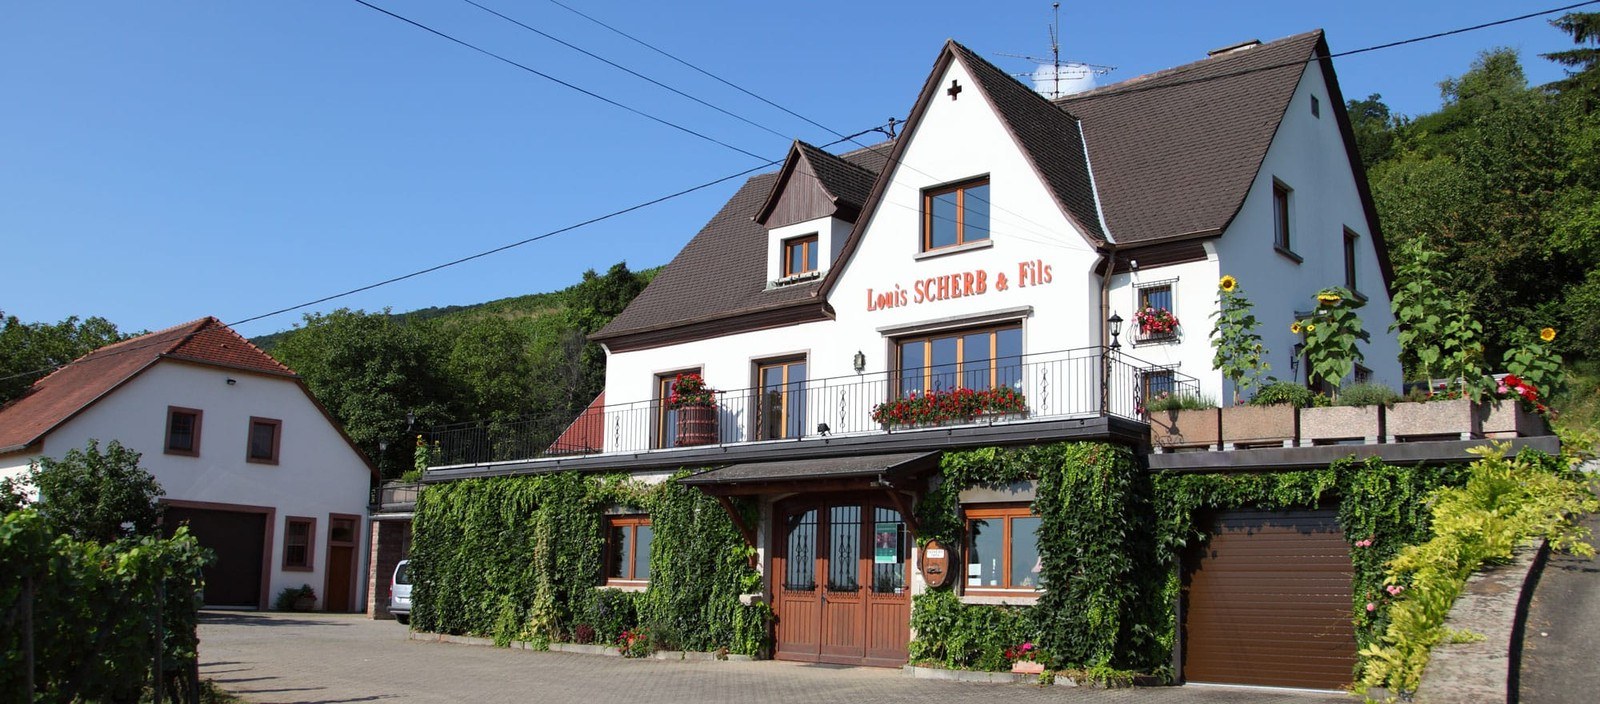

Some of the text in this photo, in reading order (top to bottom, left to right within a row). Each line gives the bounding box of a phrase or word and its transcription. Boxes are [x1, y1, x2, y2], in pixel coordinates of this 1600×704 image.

[867, 259, 1053, 312] Louis SCHERB & Fils
